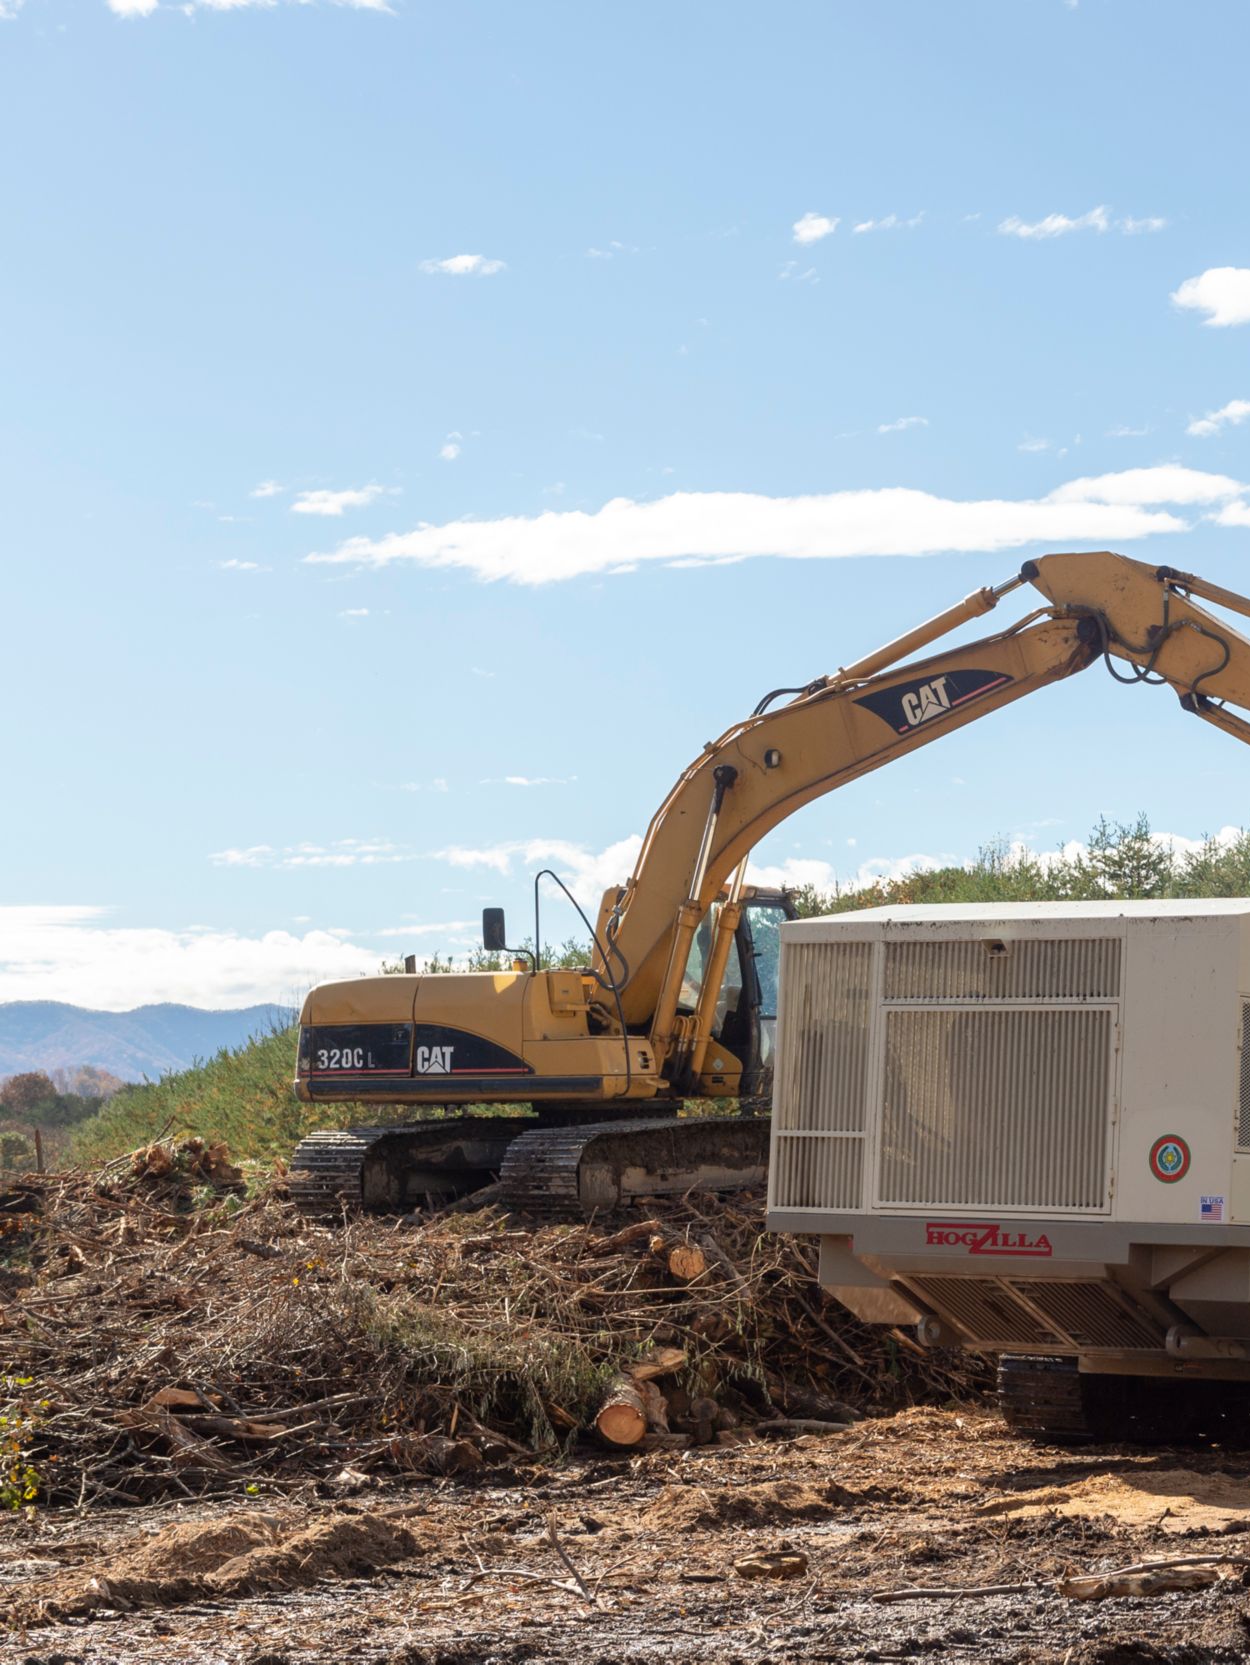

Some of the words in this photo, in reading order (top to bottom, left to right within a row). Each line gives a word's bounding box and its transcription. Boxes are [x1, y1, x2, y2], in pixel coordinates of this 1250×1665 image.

[901, 676, 951, 725] CAT
[318, 1048, 363, 1069] 320C
[416, 1046, 454, 1073] CAT
[926, 1223, 1052, 1256] HOGZILLA
